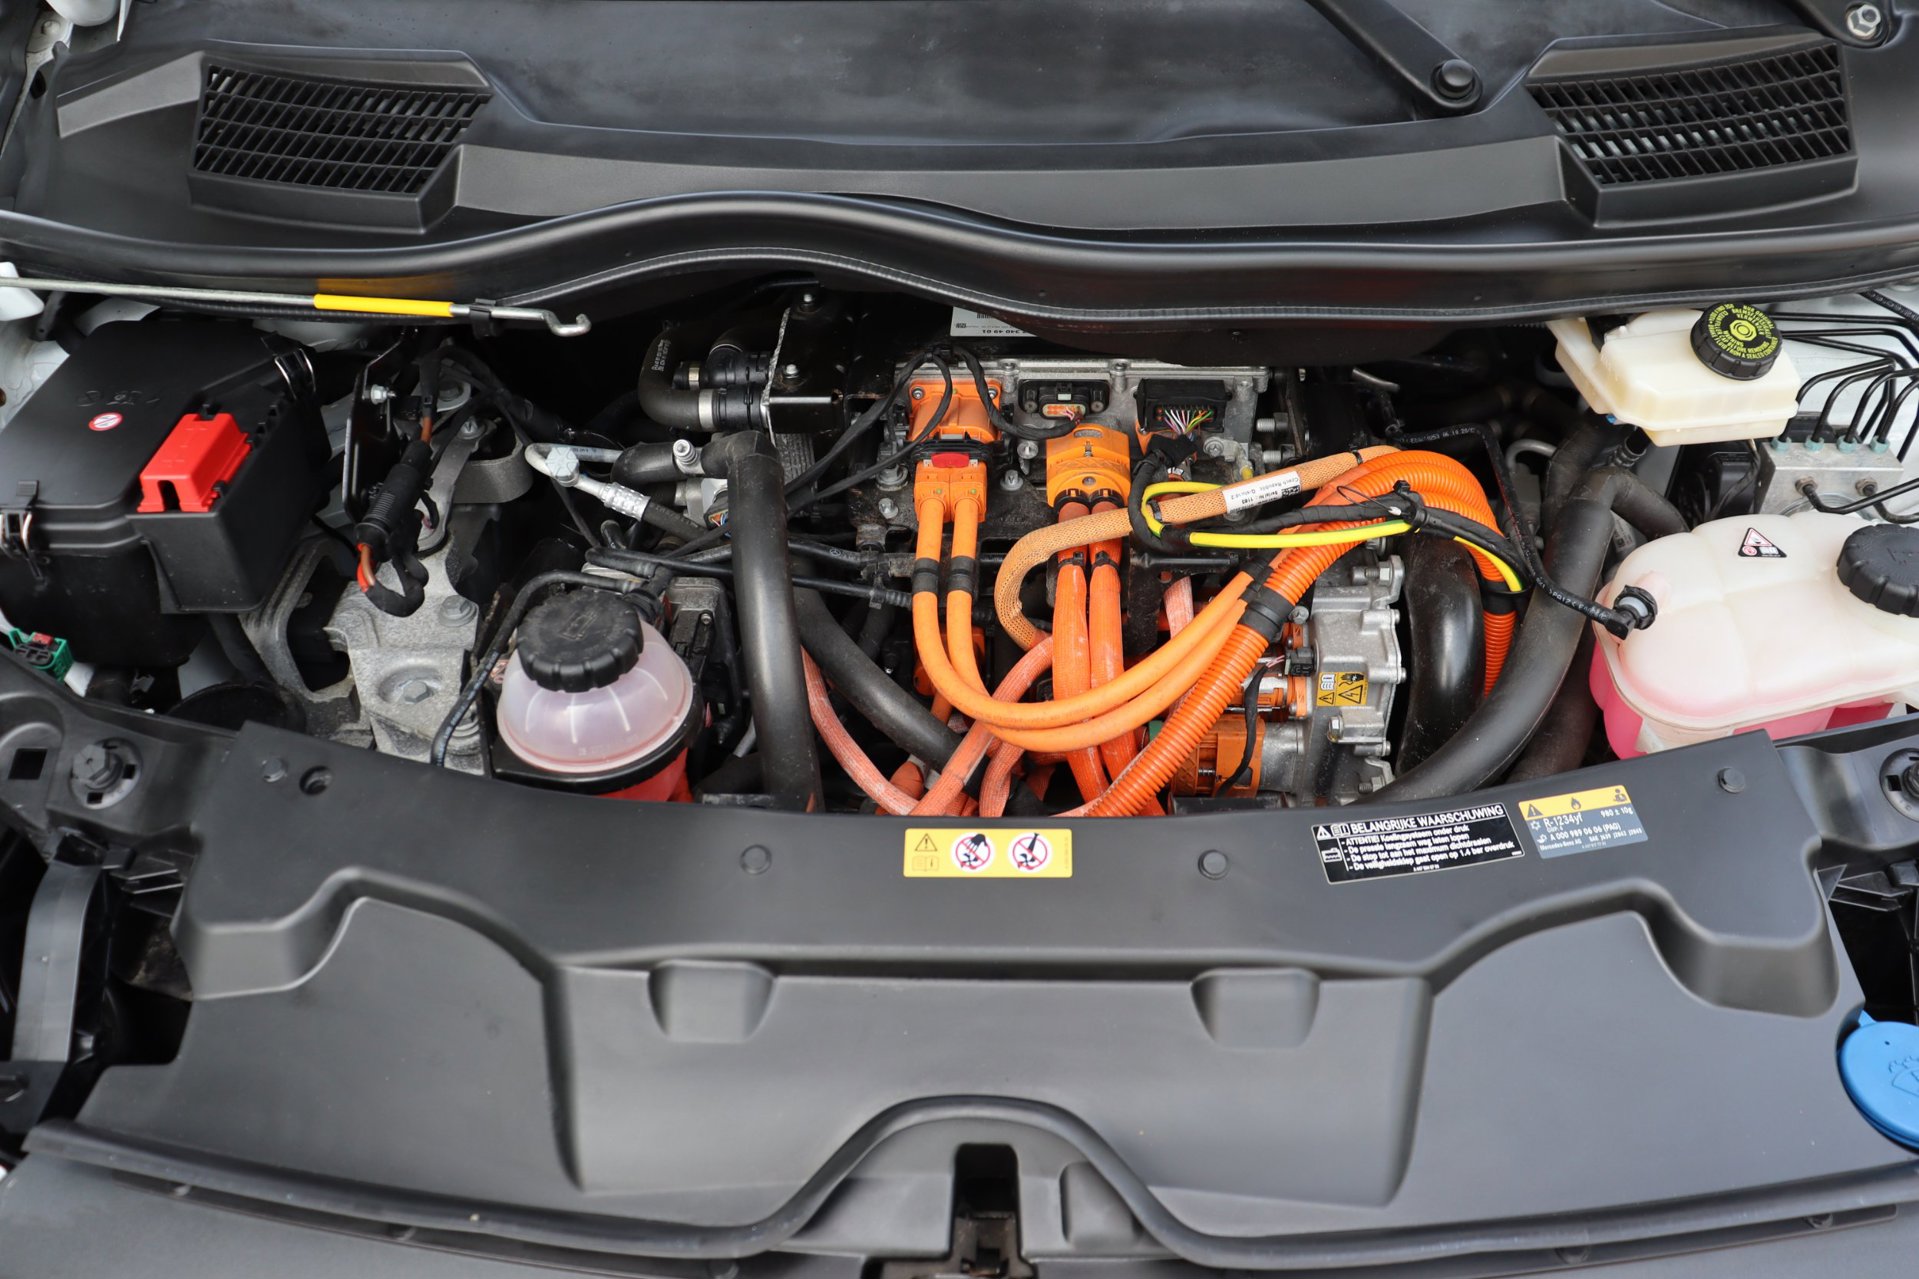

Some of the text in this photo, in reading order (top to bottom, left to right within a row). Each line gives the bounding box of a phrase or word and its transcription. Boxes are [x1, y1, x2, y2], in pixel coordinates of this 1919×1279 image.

[1743, 305, 1775, 329] NUR ORIGINAL
[1264, 490, 1278, 498] Serial
[1350, 805, 1504, 834] BELANGRIJKE WAARSCHUWING
[1543, 812, 1583, 827] R-1234yf
[1600, 808, 1614, 818] 980
[1620, 806, 1634, 816] 10g
[1433, 826, 1453, 836] onder
[1453, 824, 1470, 833] druk
[1556, 831, 1569, 840] 000
[1570, 829, 1583, 838] 989
[1583, 827, 1593, 836] 06
[1593, 826, 1602, 834] 06
[1348, 845, 1359, 854] De
[1431, 835, 1450, 845] laten
[1449, 833, 1470, 843] lopen
[1350, 853, 1361, 863] De
[1378, 851, 1389, 860] tot
[1402, 847, 1415, 857] het
[1353, 862, 1364, 871] De
[1430, 853, 1449, 863] open
[1448, 851, 1459, 860] op
[1460, 849, 1471, 857] 1.4
[1470, 846, 1484, 856] bar
[1484, 840, 1515, 853] overdruk
